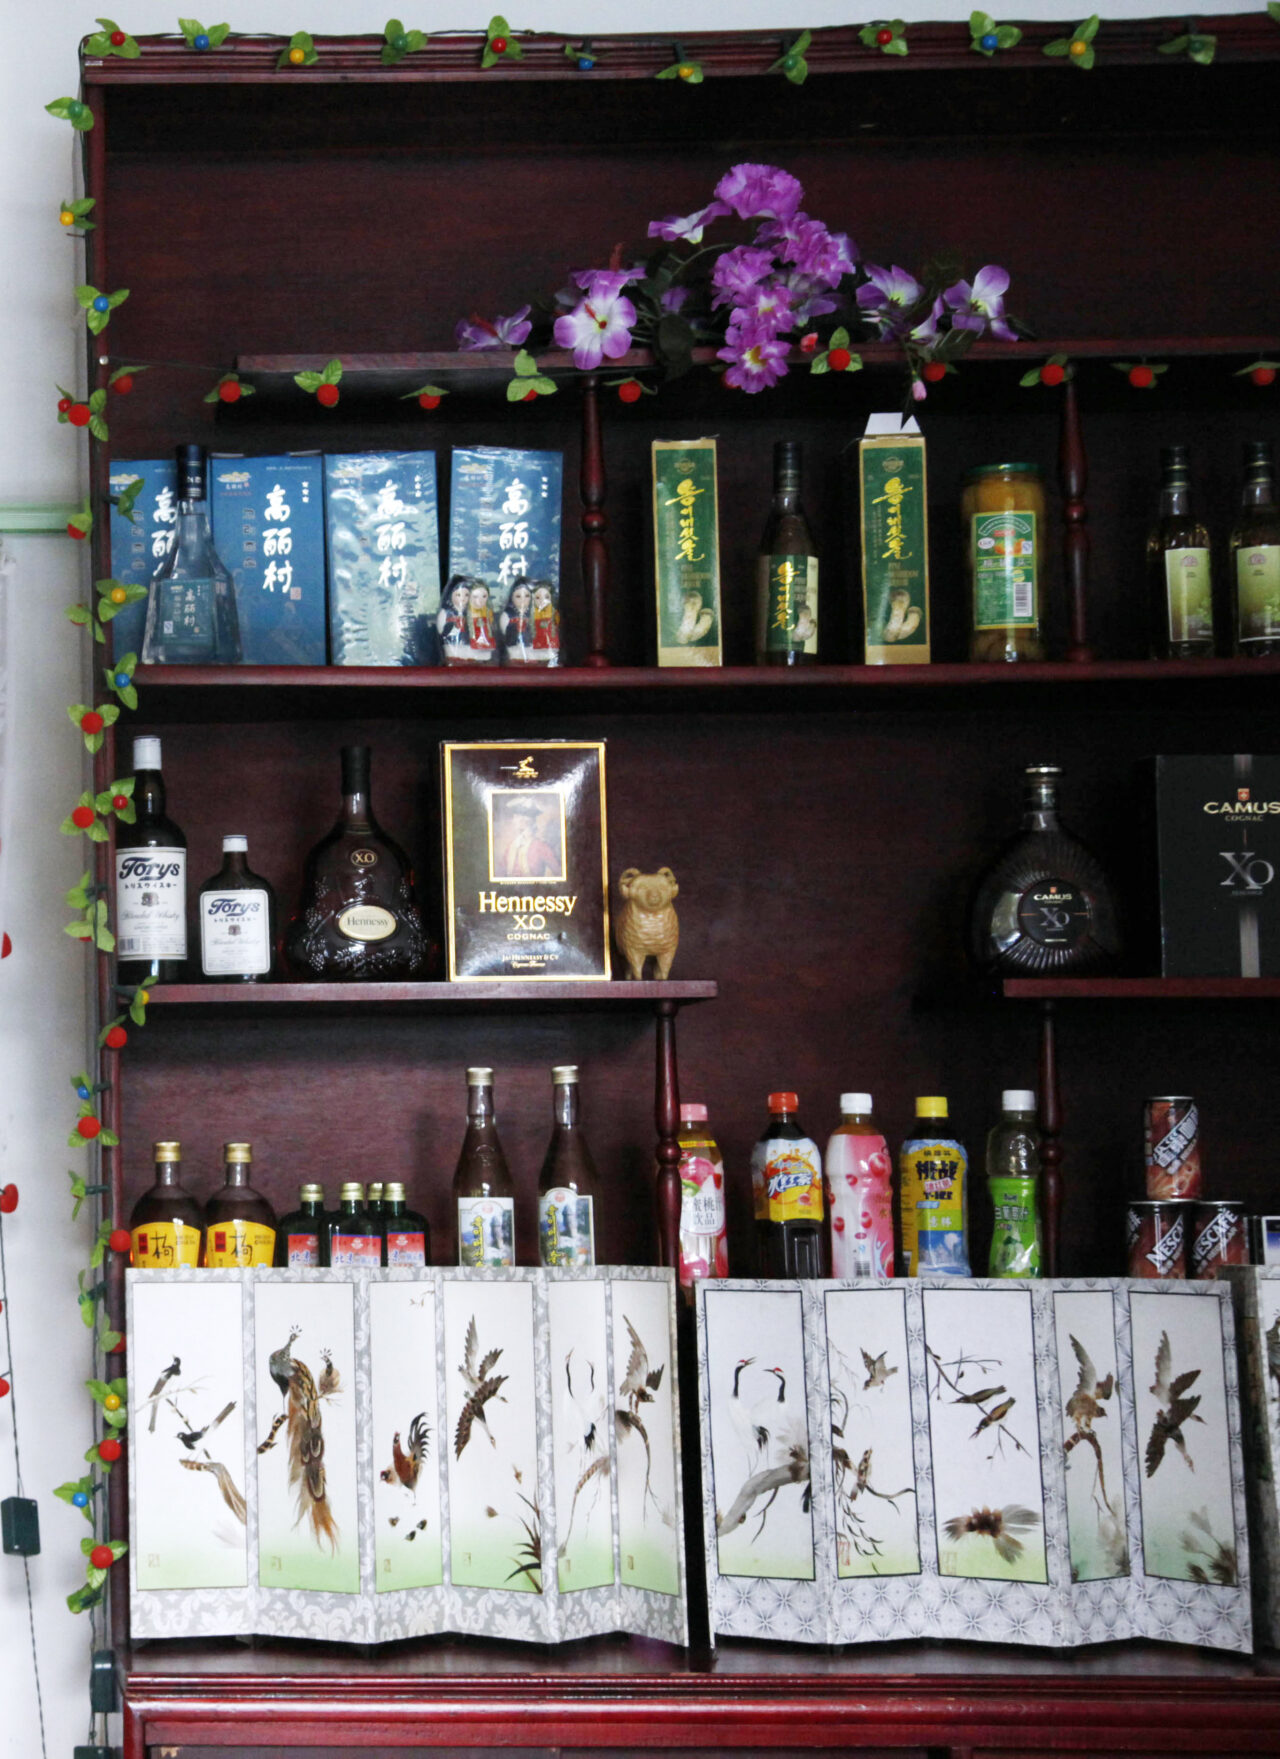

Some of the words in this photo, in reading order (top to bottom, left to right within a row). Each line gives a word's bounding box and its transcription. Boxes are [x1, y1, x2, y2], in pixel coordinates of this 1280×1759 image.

[151, 486, 179, 580] 高丽
[262, 484, 293, 593] 高丽村
[376, 479, 408, 588] 高丽村
[1203, 801, 1280, 815] CAMUS
[1224, 814, 1264, 822] COGNAC
[118, 856, 181, 881] Torys
[1219, 851, 1276, 891] XO
[207, 897, 261, 917] Torys
[478, 891, 578, 916] Hennessy
[1033, 893, 1073, 901] CAMUS
[346, 916, 391, 928] Hennessy
[506, 932, 551, 941] COGNAC
